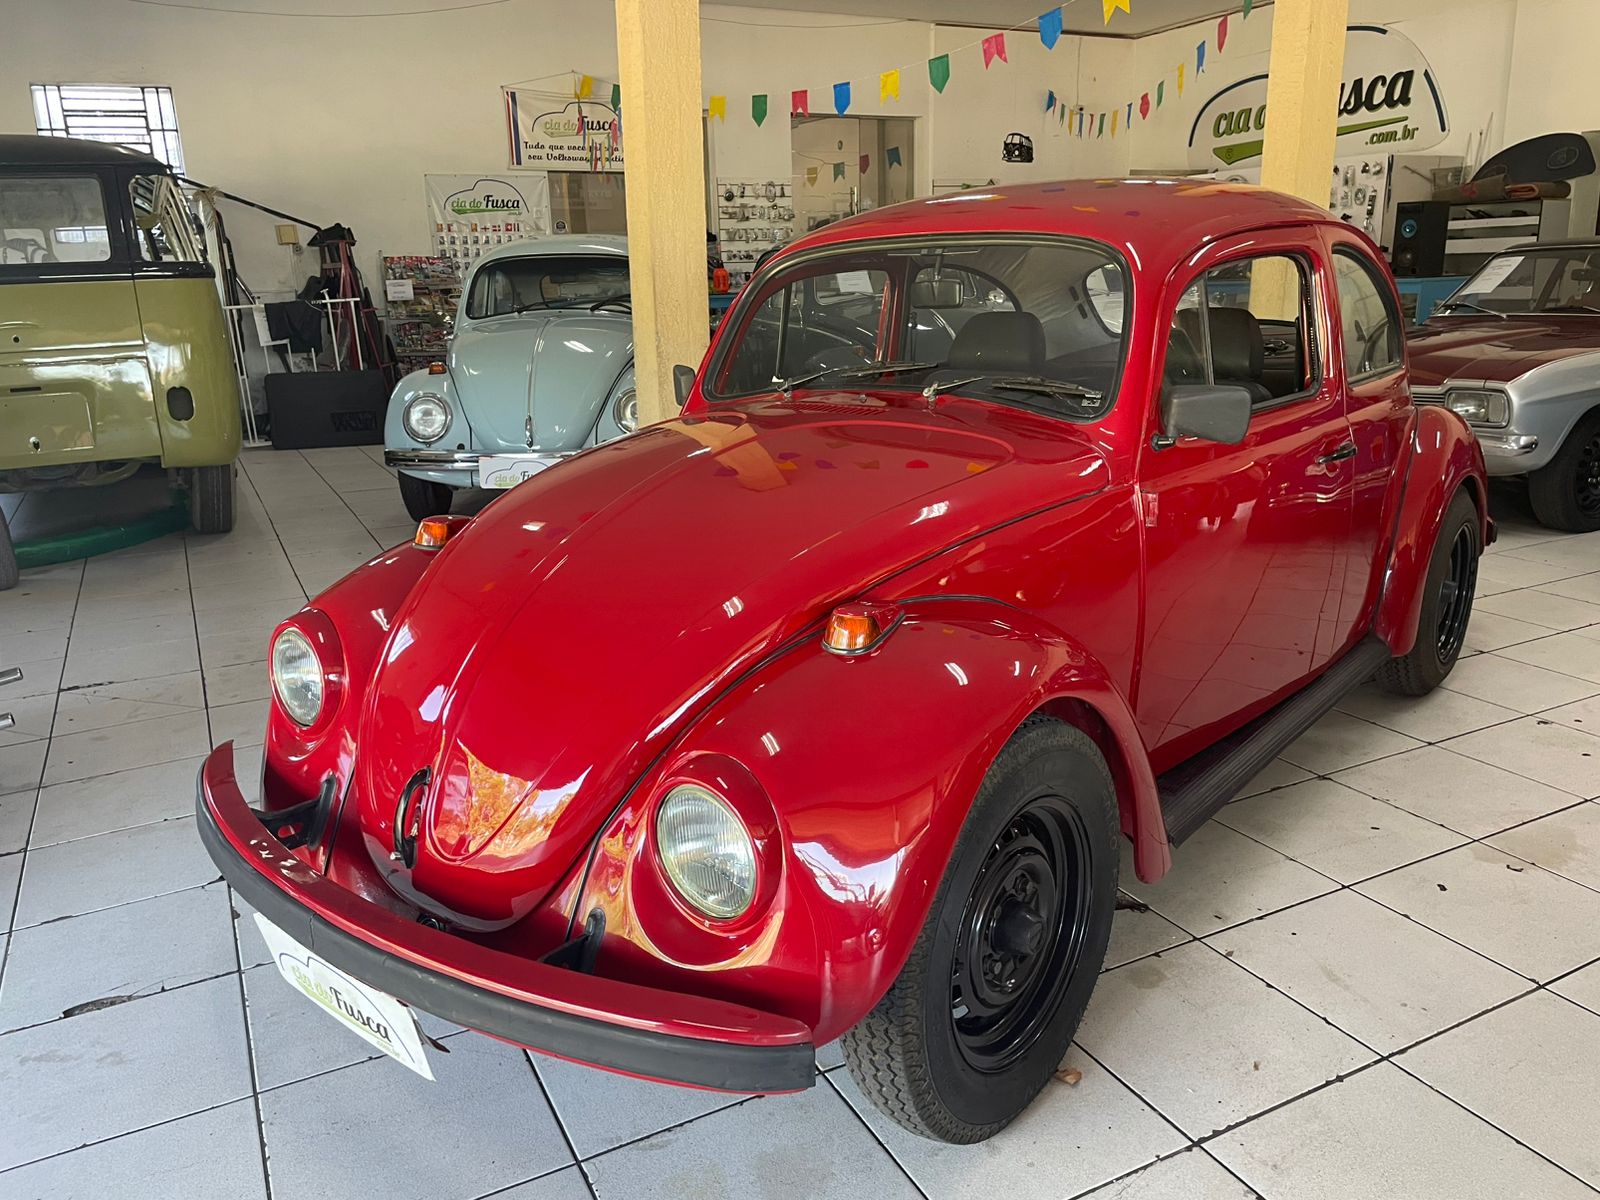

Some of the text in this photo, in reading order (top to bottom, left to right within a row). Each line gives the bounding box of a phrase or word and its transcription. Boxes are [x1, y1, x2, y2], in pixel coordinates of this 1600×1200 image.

[1212, 106, 1252, 138] cia
[1337, 69, 1415, 119] sca
[578, 115, 615, 131] usc
[1364, 124, 1419, 146] .com.br
[523, 140, 545, 150] Tudo
[548, 144, 565, 152] que
[451, 194, 520, 209] cia do Fusca
[329, 986, 392, 1043] Fusca
